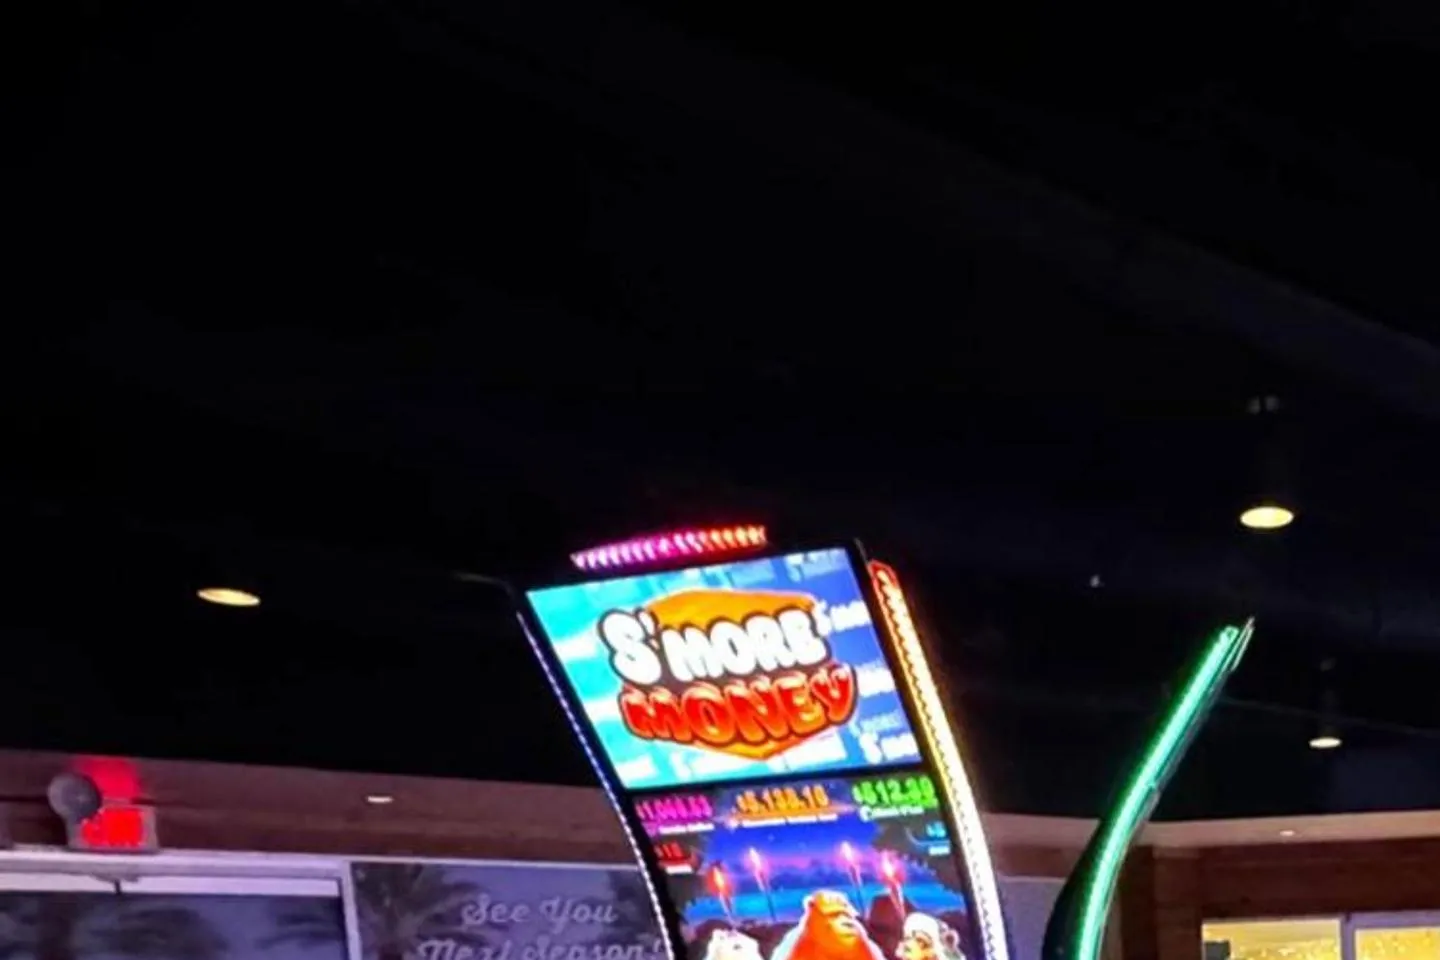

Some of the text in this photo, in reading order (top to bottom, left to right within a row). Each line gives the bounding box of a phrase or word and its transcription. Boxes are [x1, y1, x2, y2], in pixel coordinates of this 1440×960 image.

[602, 607, 829, 685] S'MORE
[621, 665, 857, 745] MONEY
[460, 893, 619, 934] See You
